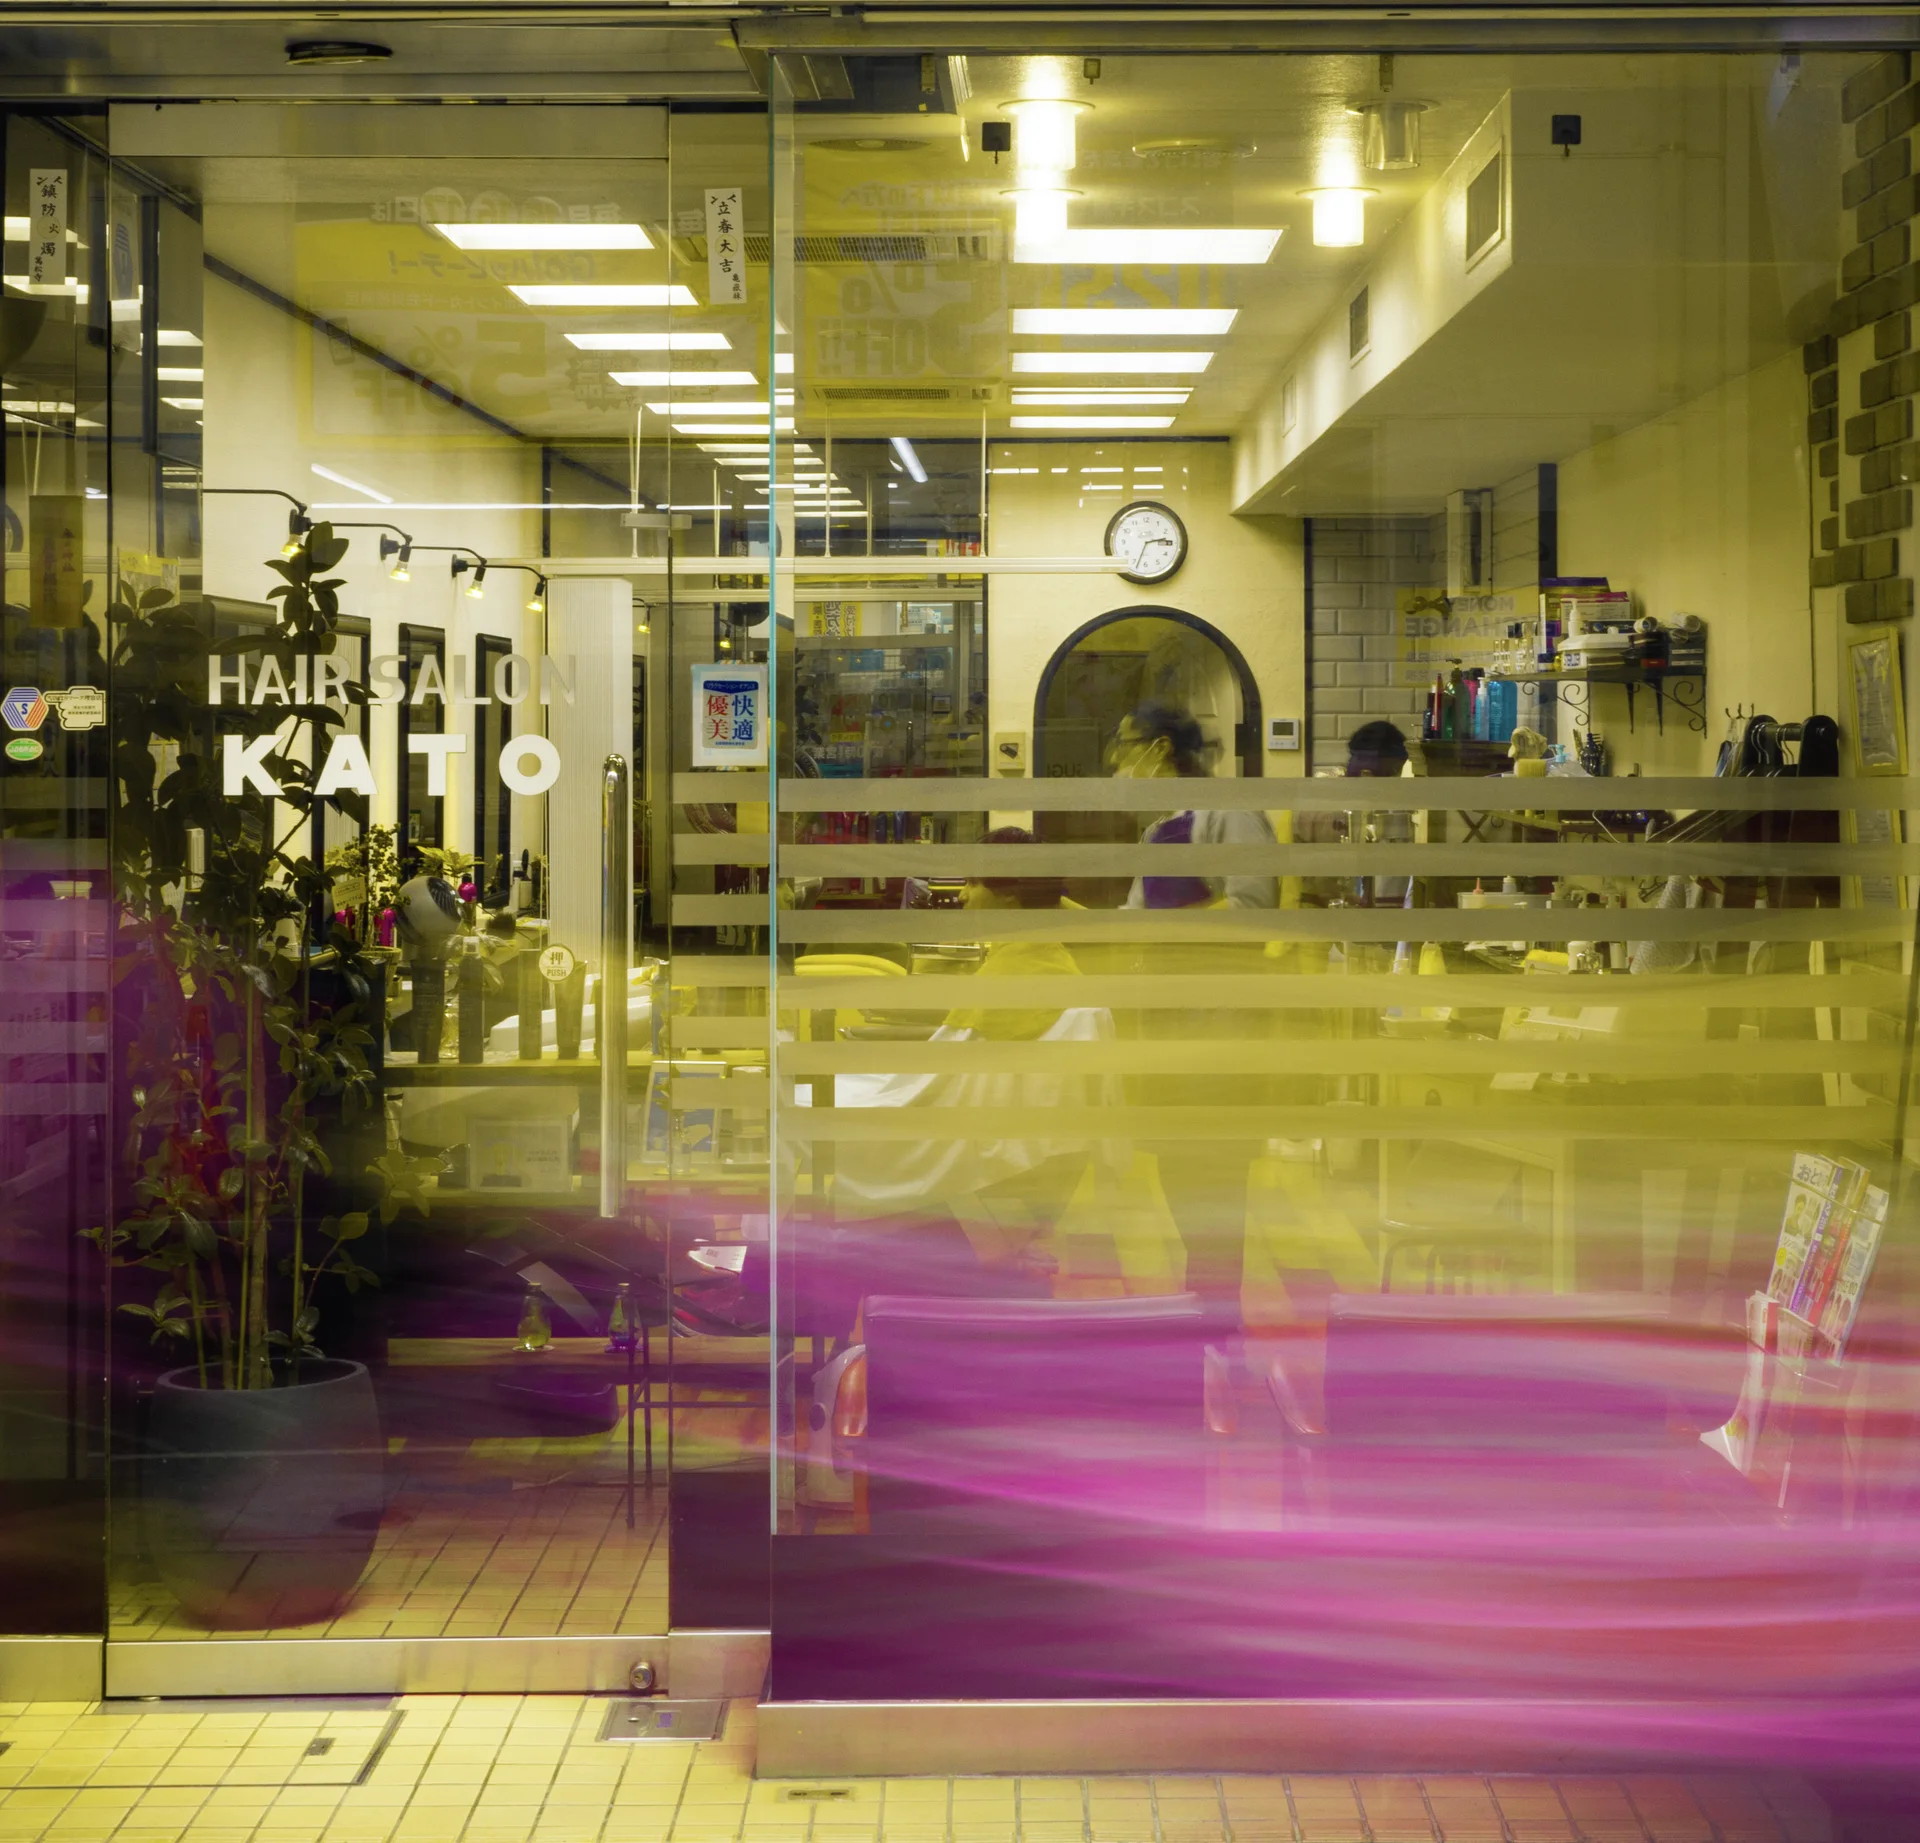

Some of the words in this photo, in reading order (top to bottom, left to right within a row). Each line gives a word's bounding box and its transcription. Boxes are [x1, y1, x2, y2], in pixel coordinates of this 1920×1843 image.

[717, 201, 735, 273] 立春大吉
[208, 654, 351, 705] HAIR
[367, 654, 577, 706] SALON
[706, 694, 729, 741] 優美
[731, 694, 755, 741] 快適
[223, 734, 561, 796] KATO
[546, 968, 567, 977] PUSH
[549, 951, 564, 965] 押
